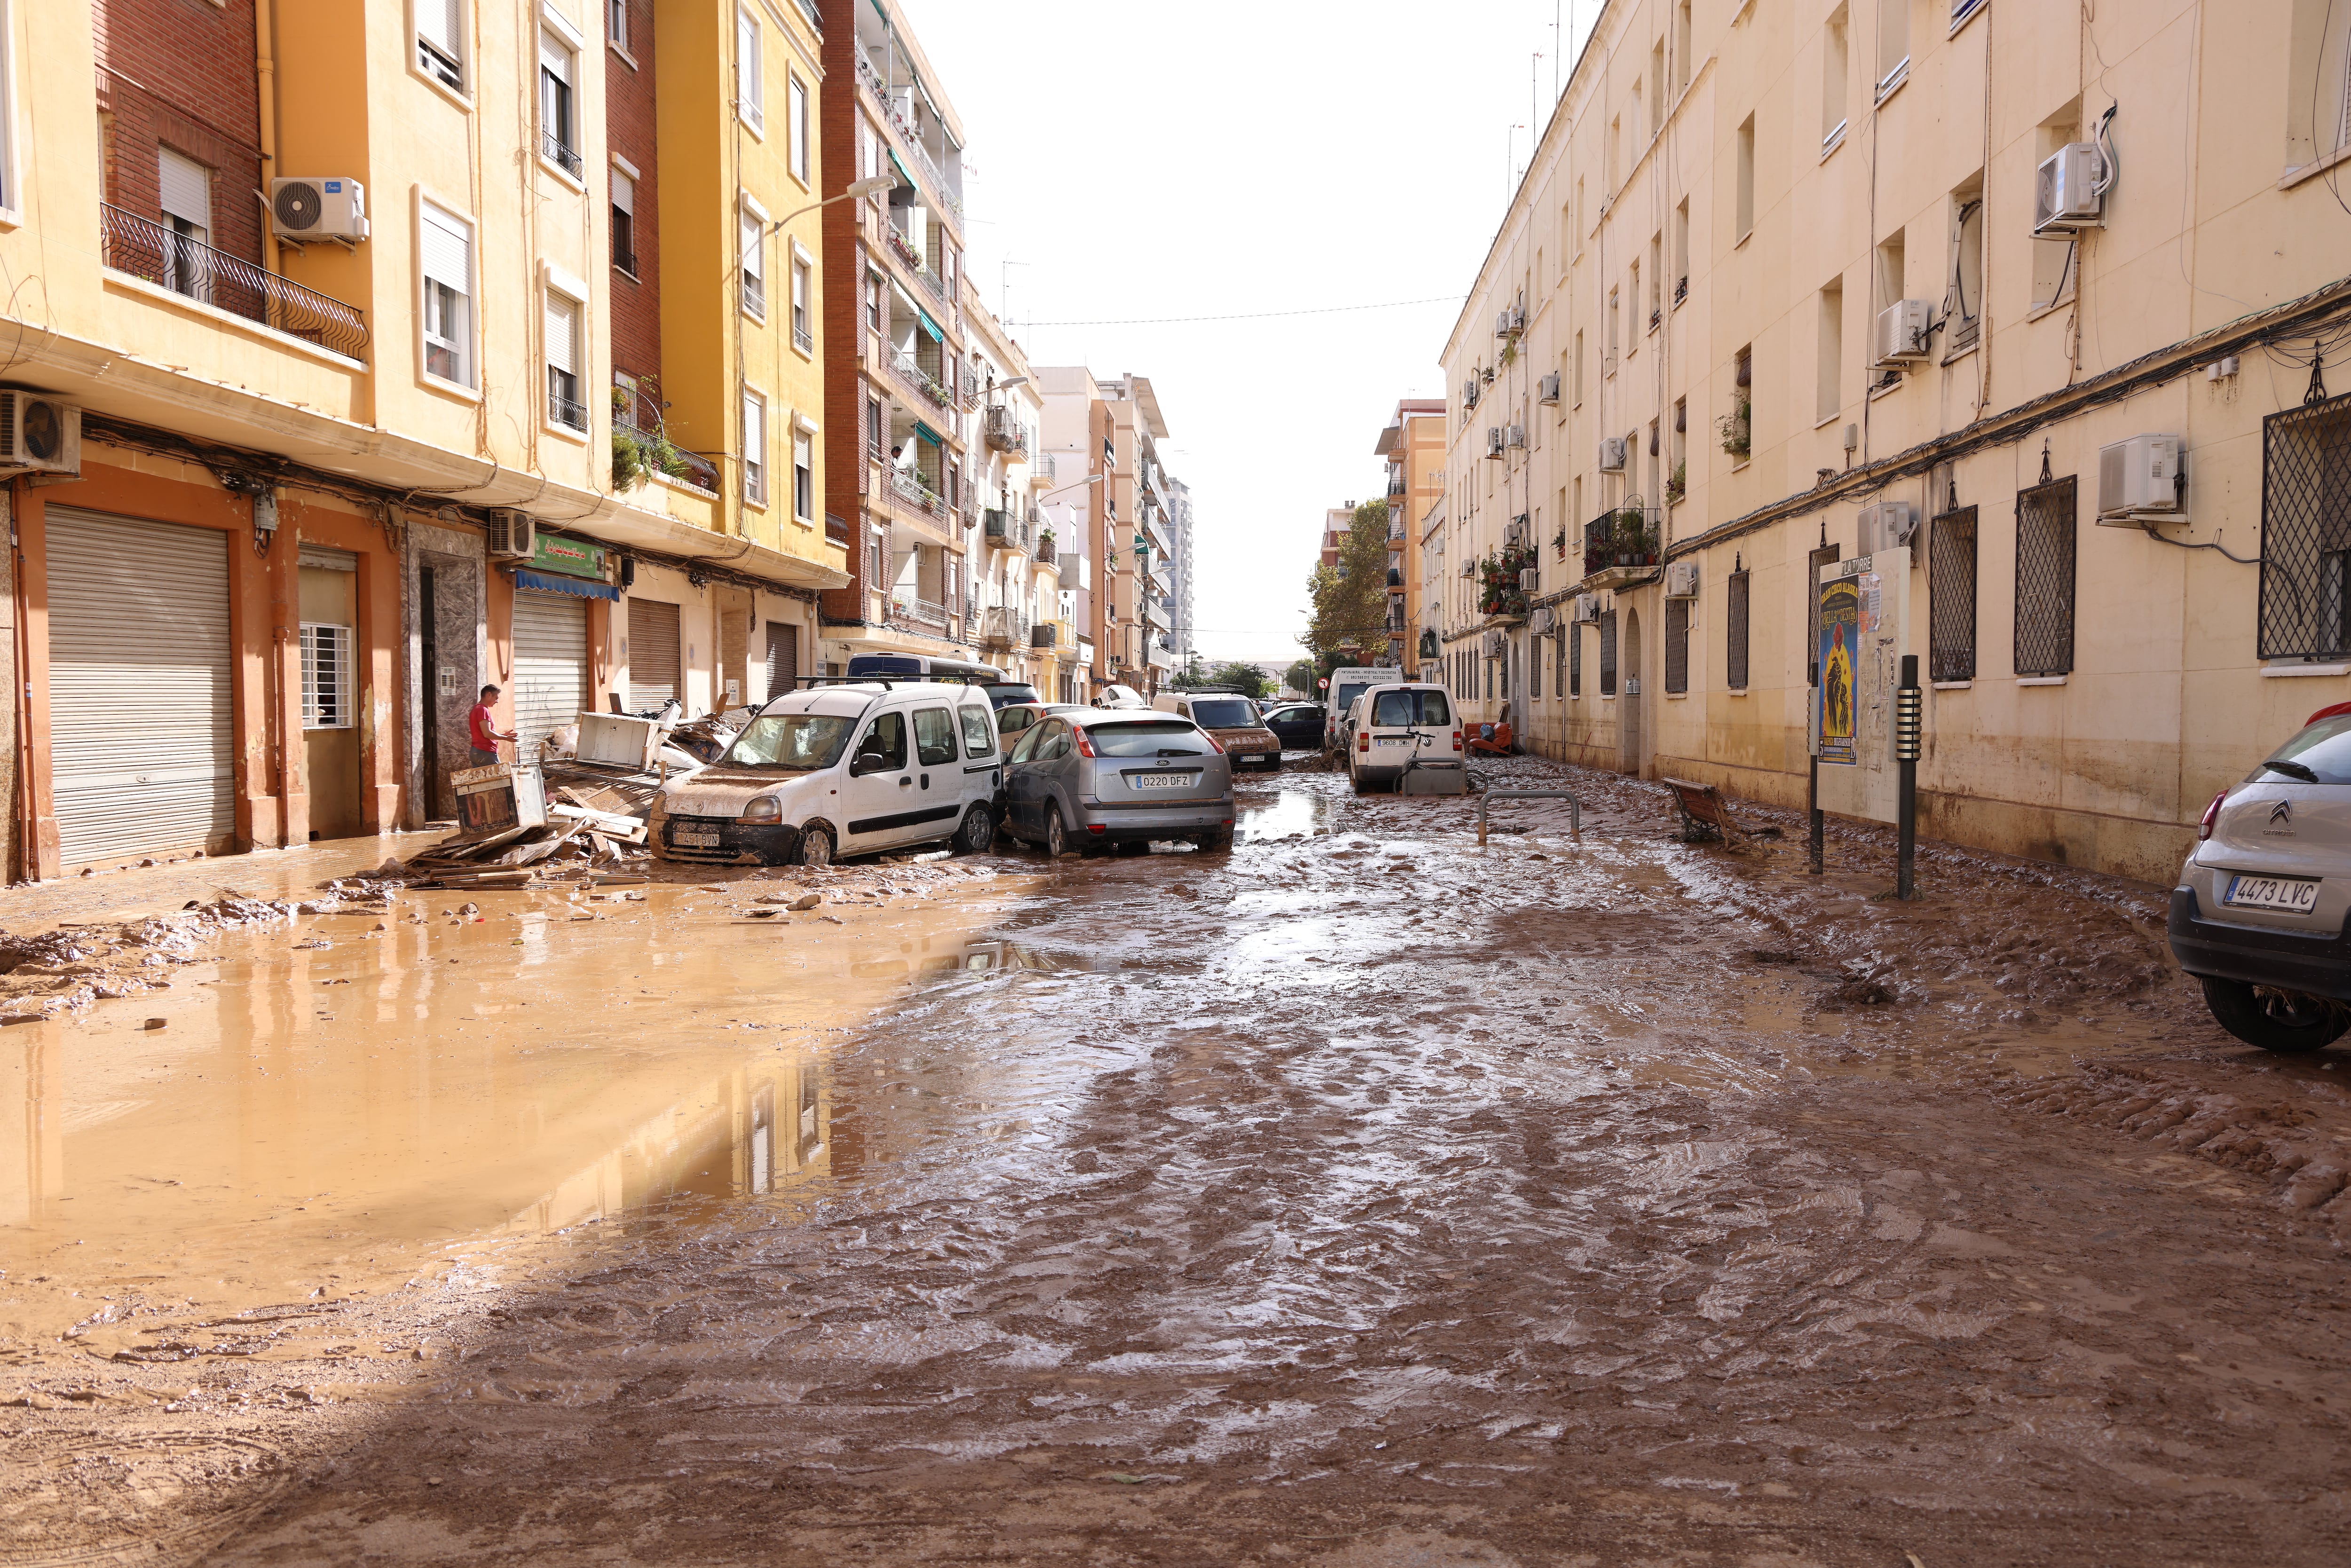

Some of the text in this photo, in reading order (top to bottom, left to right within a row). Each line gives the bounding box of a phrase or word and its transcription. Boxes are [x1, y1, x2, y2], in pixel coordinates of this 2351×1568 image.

[1844, 556, 1871, 575] LA TORRE
[1821, 586, 1831, 605] GRAN
[1831, 582, 1842, 596] CIRCO
[1842, 582, 1858, 599] ALASKA
[1822, 609, 1837, 627] BELLA
[1840, 607, 1857, 622] BESTIA
[1820, 740, 1823, 756] 5
[1144, 777, 1168, 786] 0220
[1170, 776, 1188, 785] DFZ
[702, 835, 717, 845] BVN
[2237, 880, 2277, 901] 4473
[2278, 882, 2314, 905] LVC
